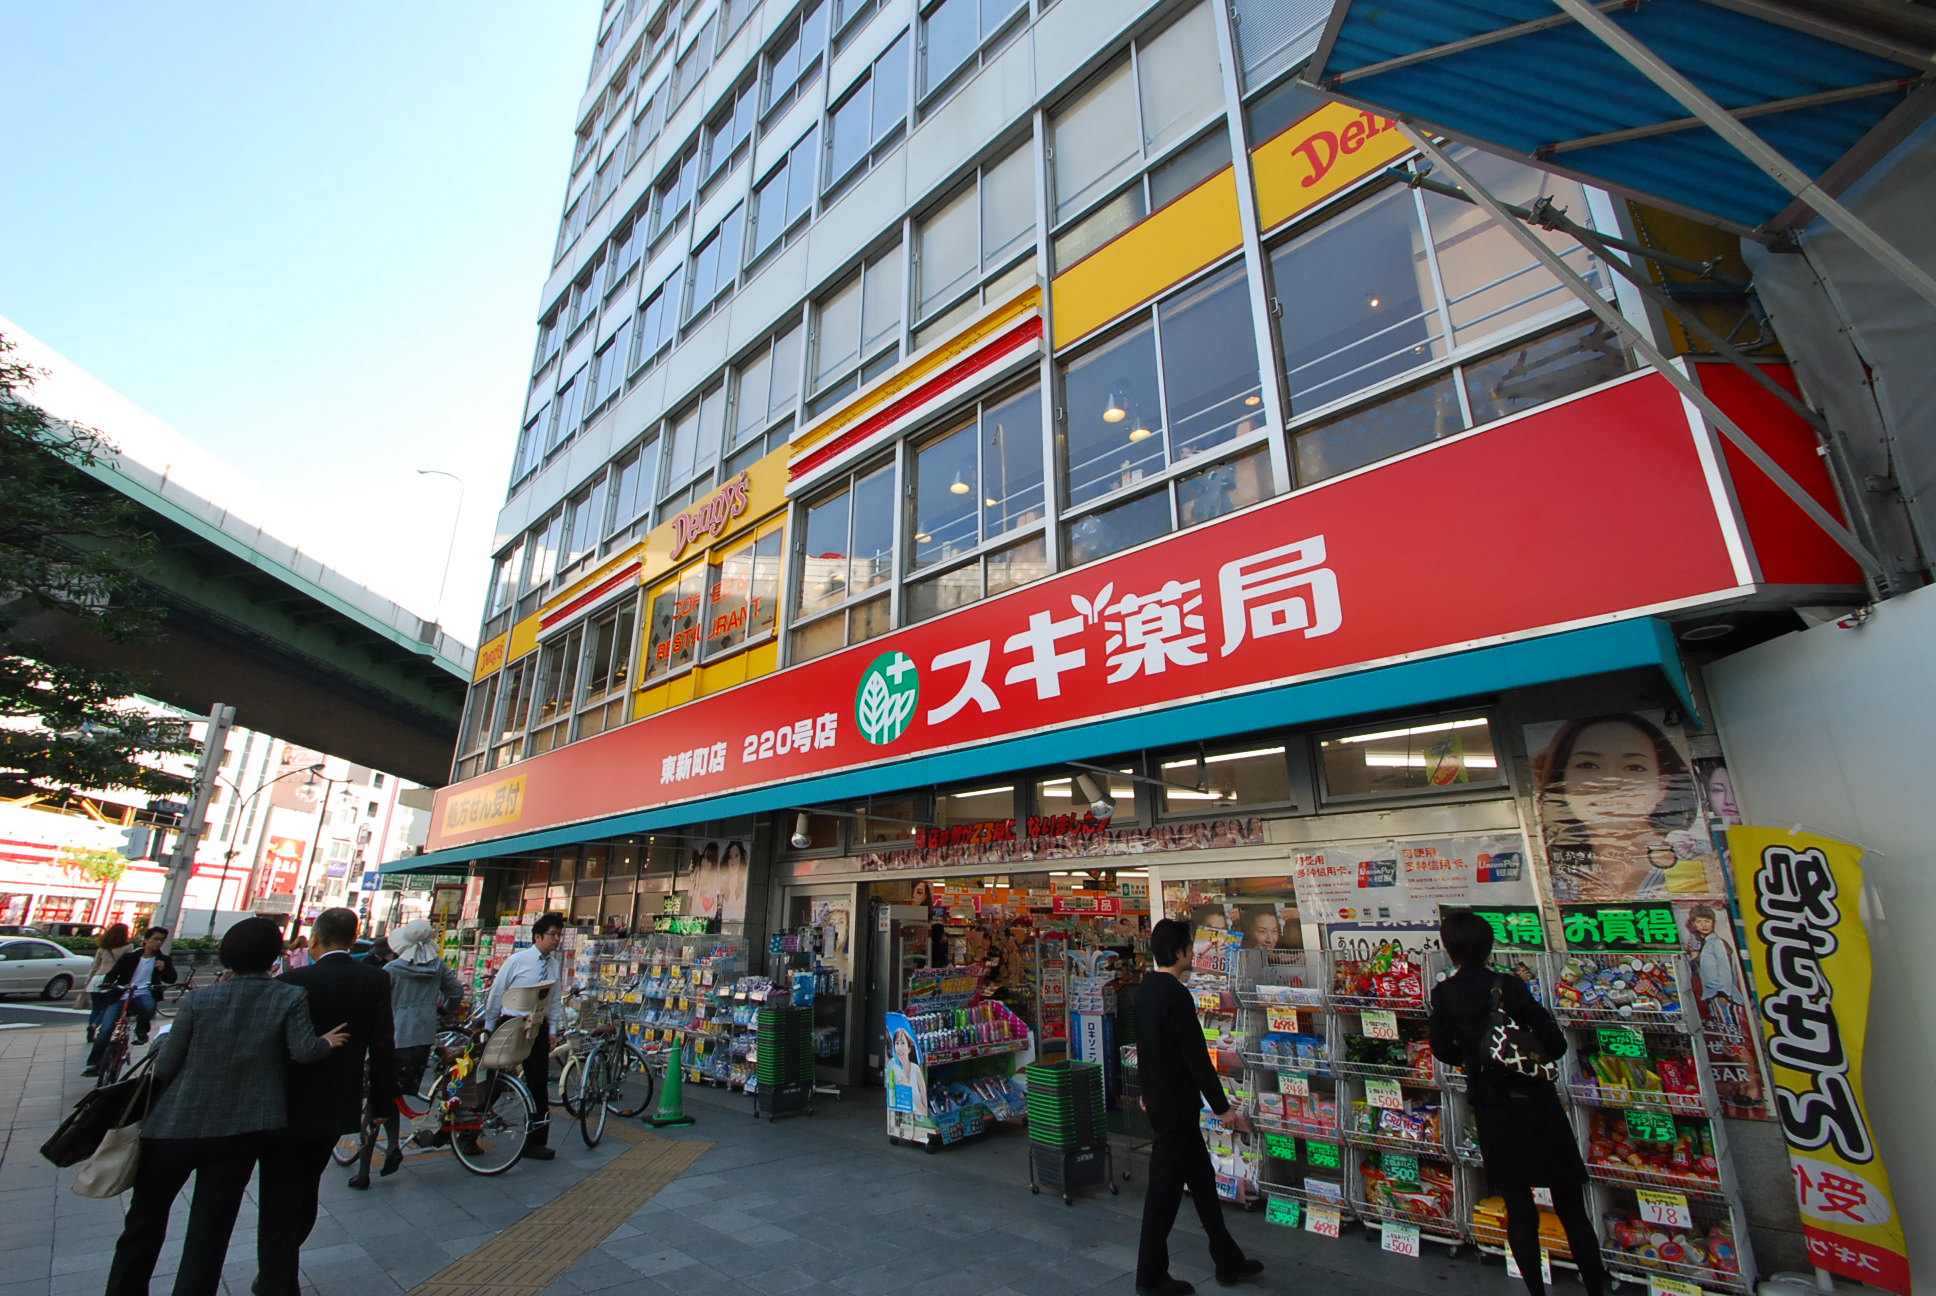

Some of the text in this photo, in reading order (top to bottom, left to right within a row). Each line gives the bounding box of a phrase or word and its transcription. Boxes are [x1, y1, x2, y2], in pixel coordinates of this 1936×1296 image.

[670, 471, 750, 560] Denny's
[672, 569, 750, 619] COFEE &
[927, 534, 1343, 726] スギ薬局
[660, 713, 838, 784] 東新町店 220号店
[446, 782, 520, 829] 処方せん受付
[1359, 866, 1395, 878] UnionPay
[1478, 860, 1520, 870] UnionPay
[1473, 910, 1545, 945] 買得
[1563, 908, 1679, 945] お買得
[1273, 1018, 1296, 1032] 498
[1373, 1026, 1395, 1039] 500
[1609, 1043, 1641, 1057] 98
[1711, 1067, 1751, 1082] BAR
[1378, 1095, 1400, 1109] 500
[1636, 1126, 1671, 1142] 75
[1391, 1167, 1415, 1180] 500
[1651, 1206, 1678, 1225] 78
[1314, 1220, 1338, 1237] 498
[1392, 1239, 1413, 1255] 500
